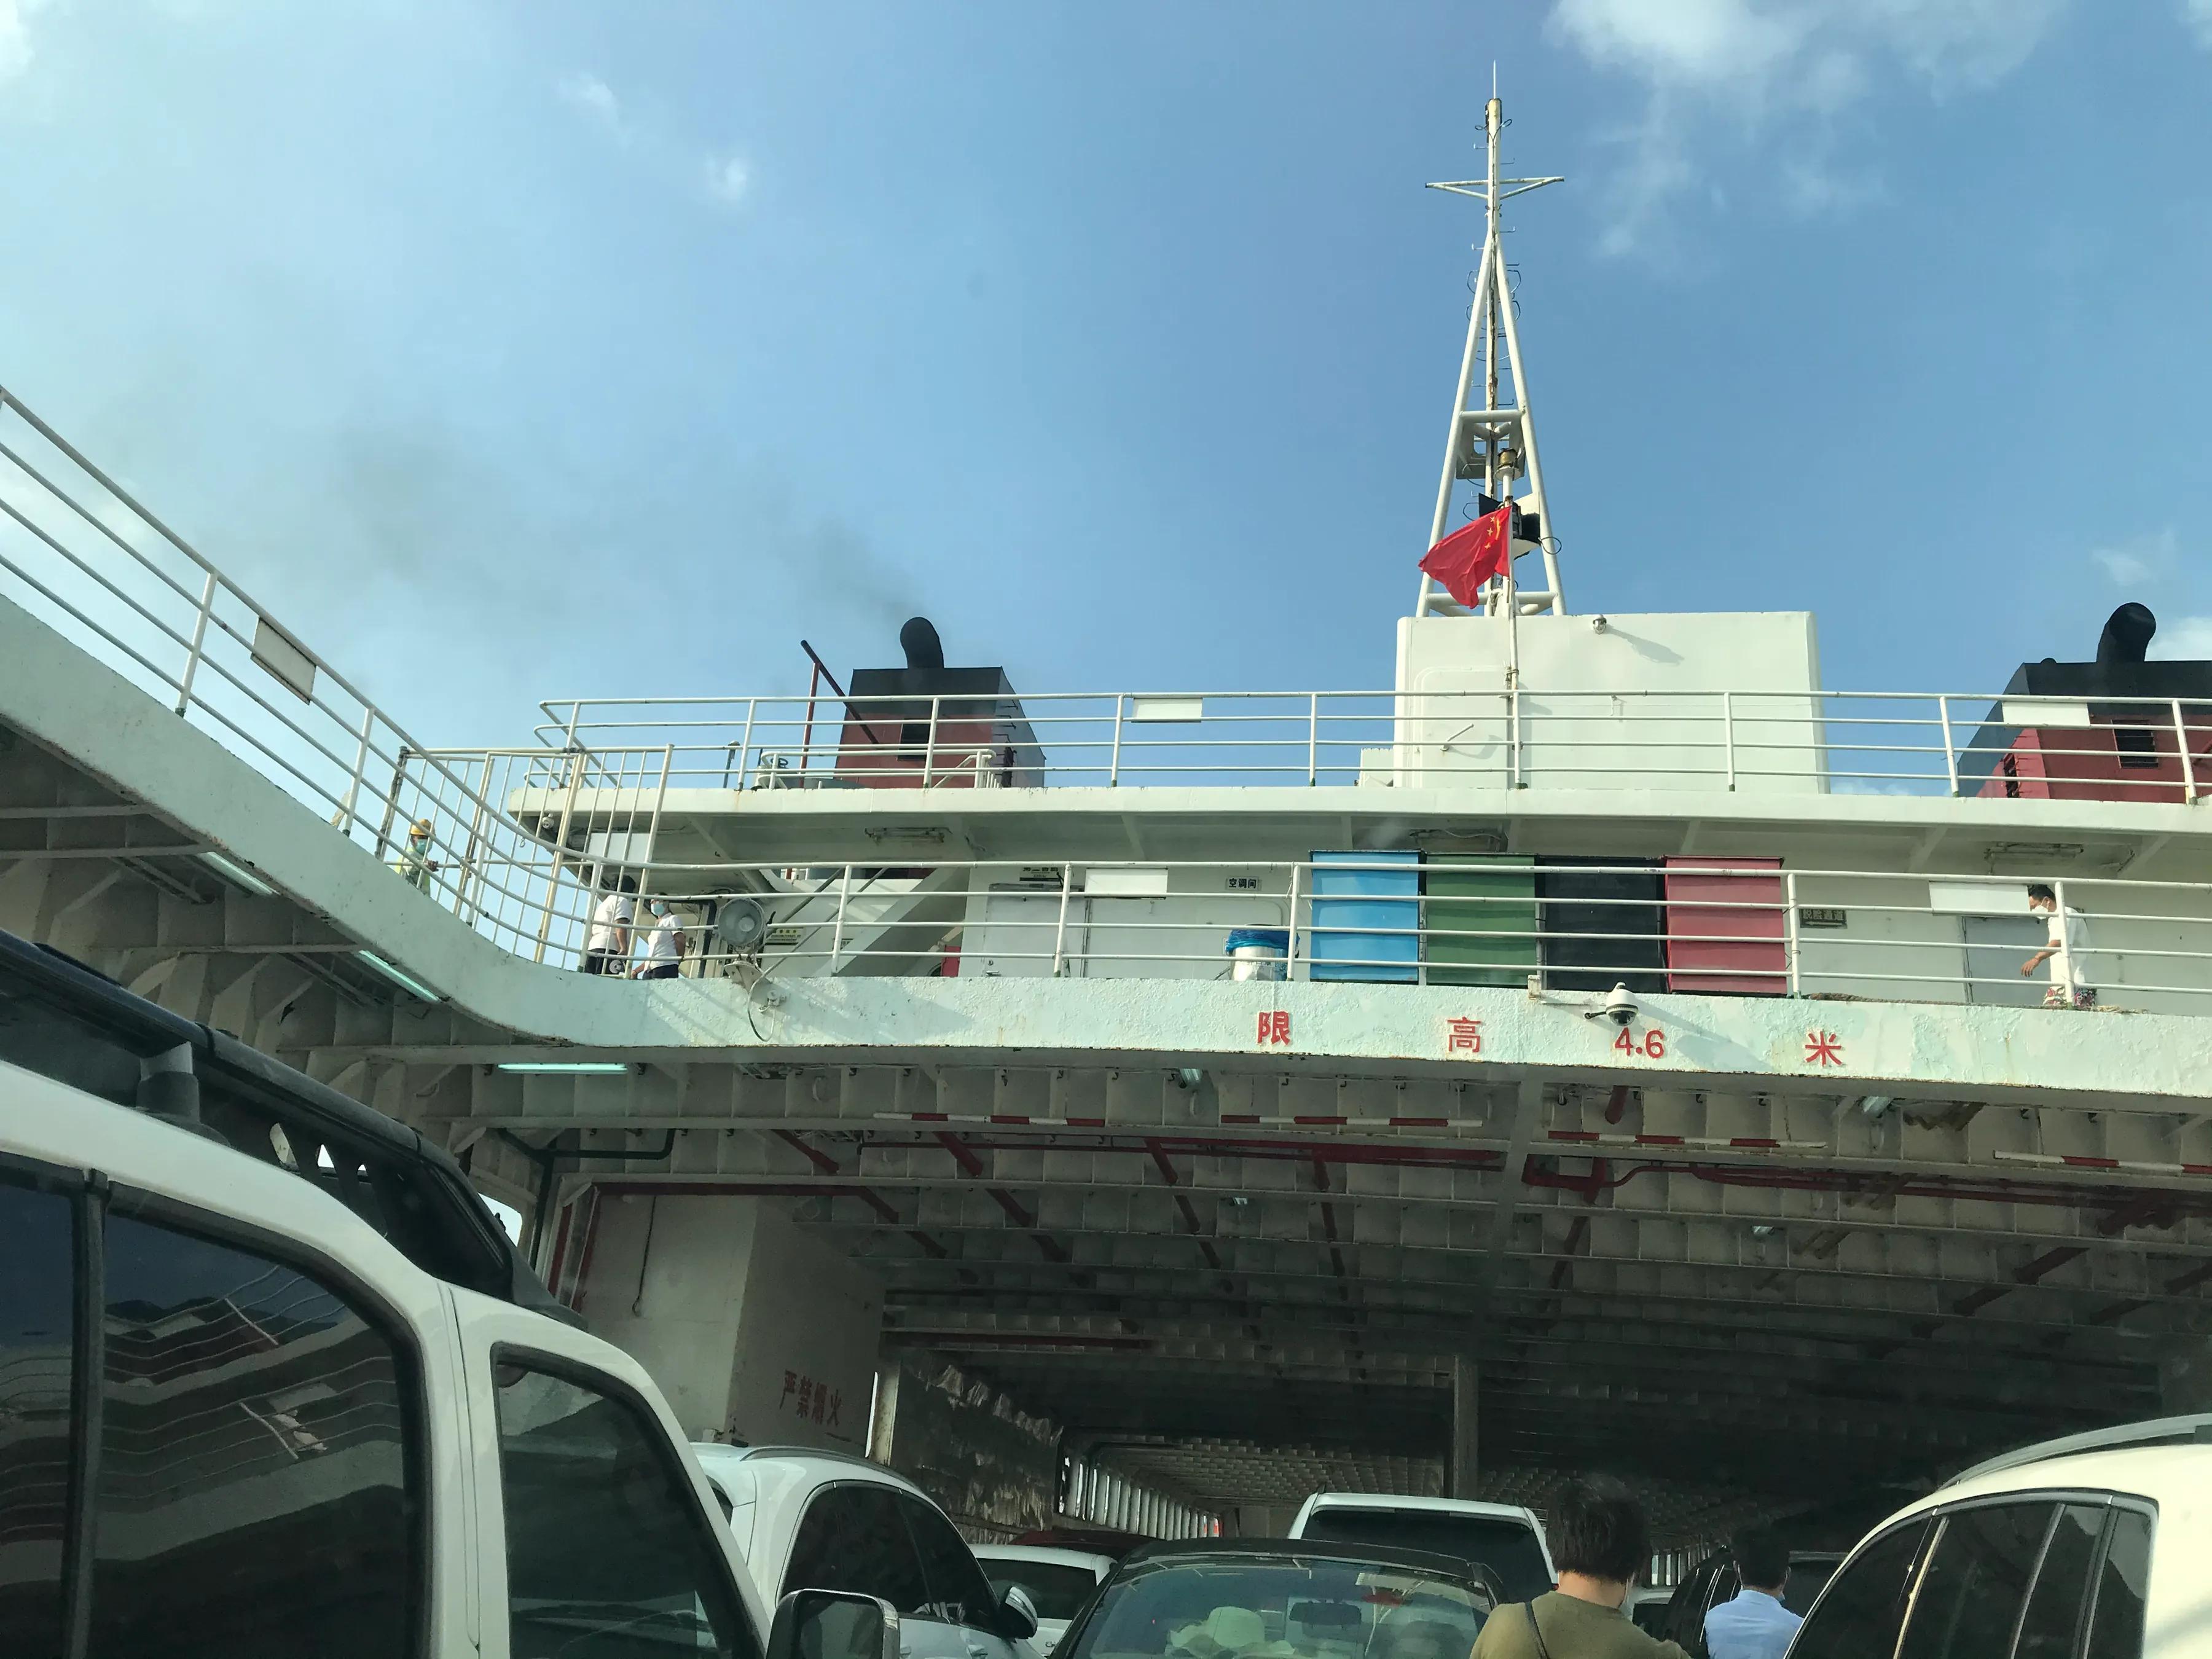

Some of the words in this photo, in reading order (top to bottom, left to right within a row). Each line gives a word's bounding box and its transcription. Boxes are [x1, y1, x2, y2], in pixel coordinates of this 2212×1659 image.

[1228, 877, 1257, 889] 空调间
[1257, 1011, 1290, 1046] 限
[1446, 1016, 1481, 1053] 高
[1614, 1027, 1665, 1059] 4.6
[1805, 1030, 1842, 1066] 米
